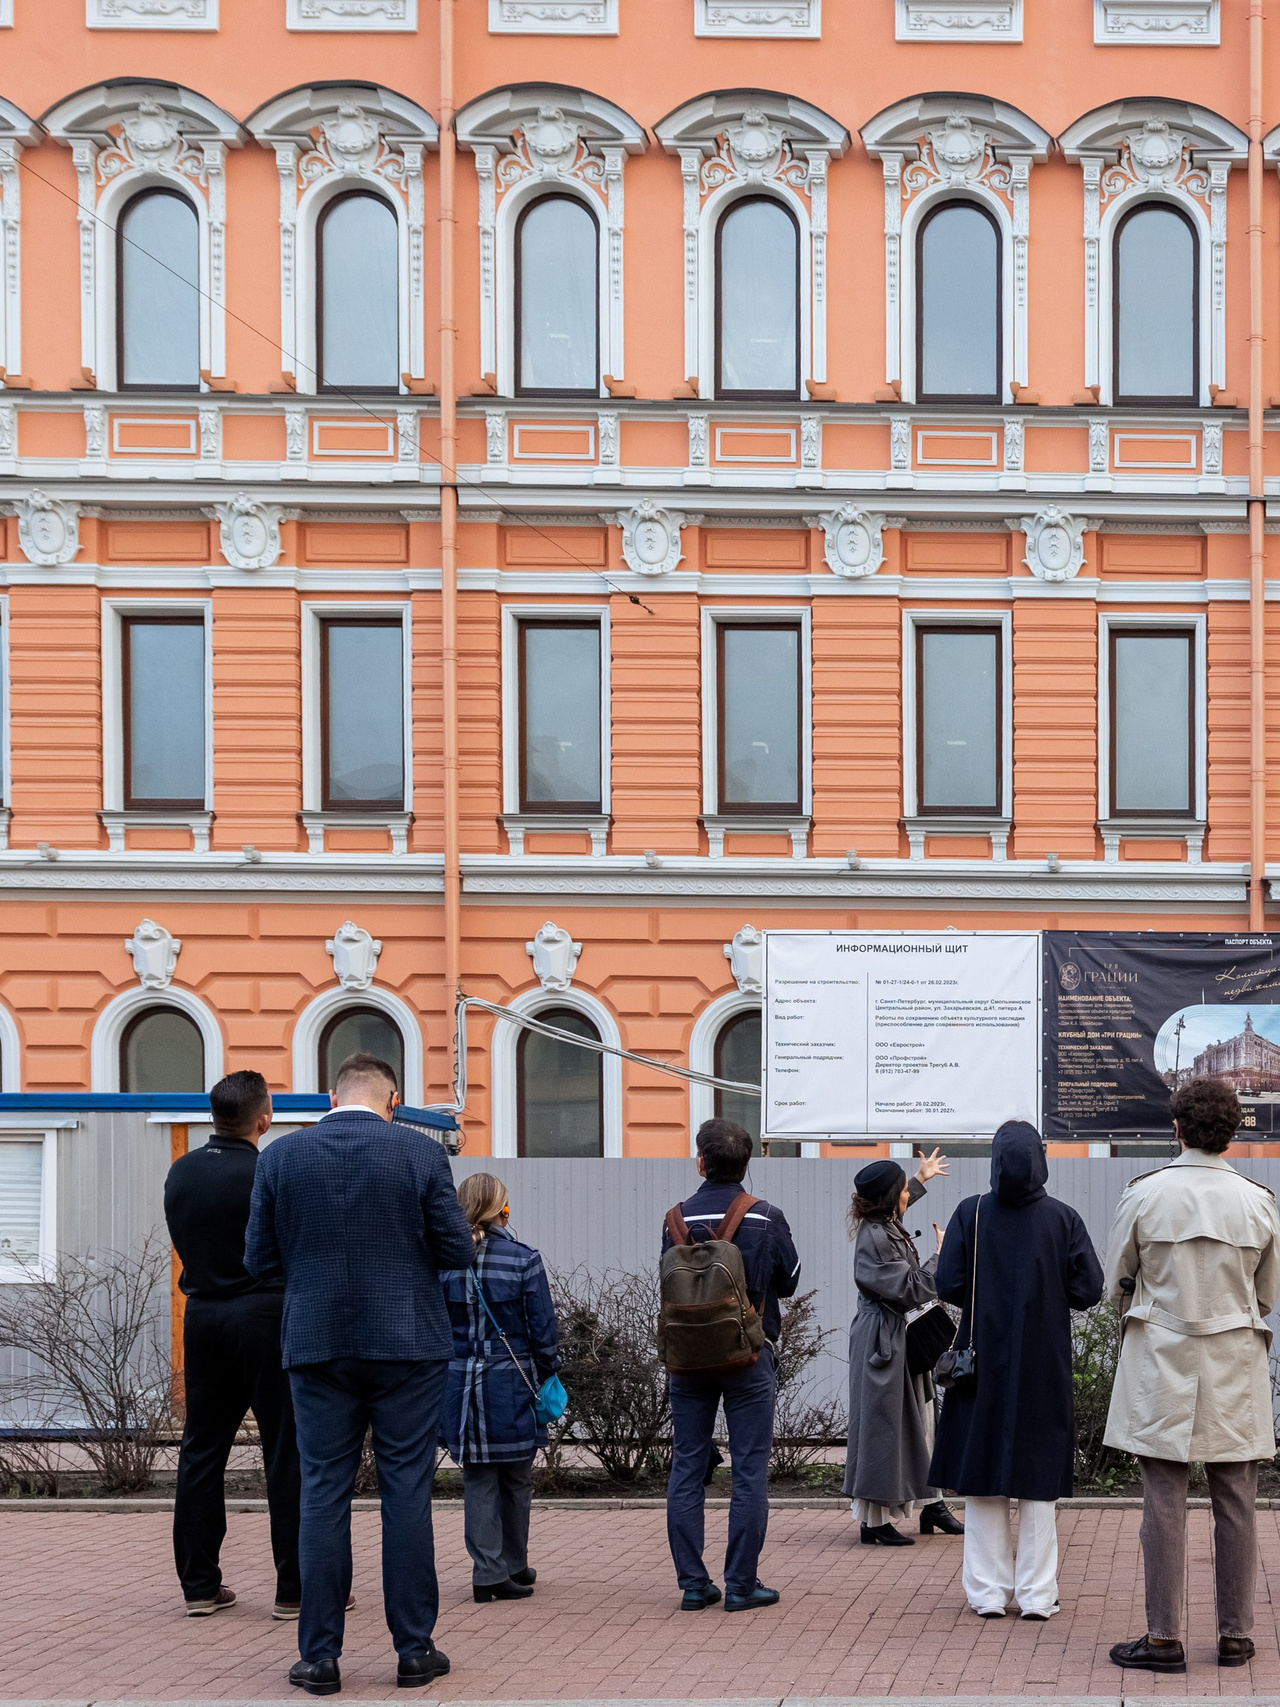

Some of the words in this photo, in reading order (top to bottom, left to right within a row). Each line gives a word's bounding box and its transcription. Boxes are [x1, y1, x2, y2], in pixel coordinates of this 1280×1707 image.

[836, 943, 942, 954] ИНФОРМАЦИОННЫЙ
[945, 943, 968, 954] ЩИТ
[1084, 971, 1138, 983] ГРАЦИИ
[1058, 1031, 1086, 1039] КЛУБНЫЙ
[1087, 1031, 1100, 1039] ДОМ
[1240, 1116, 1256, 1127] -88
